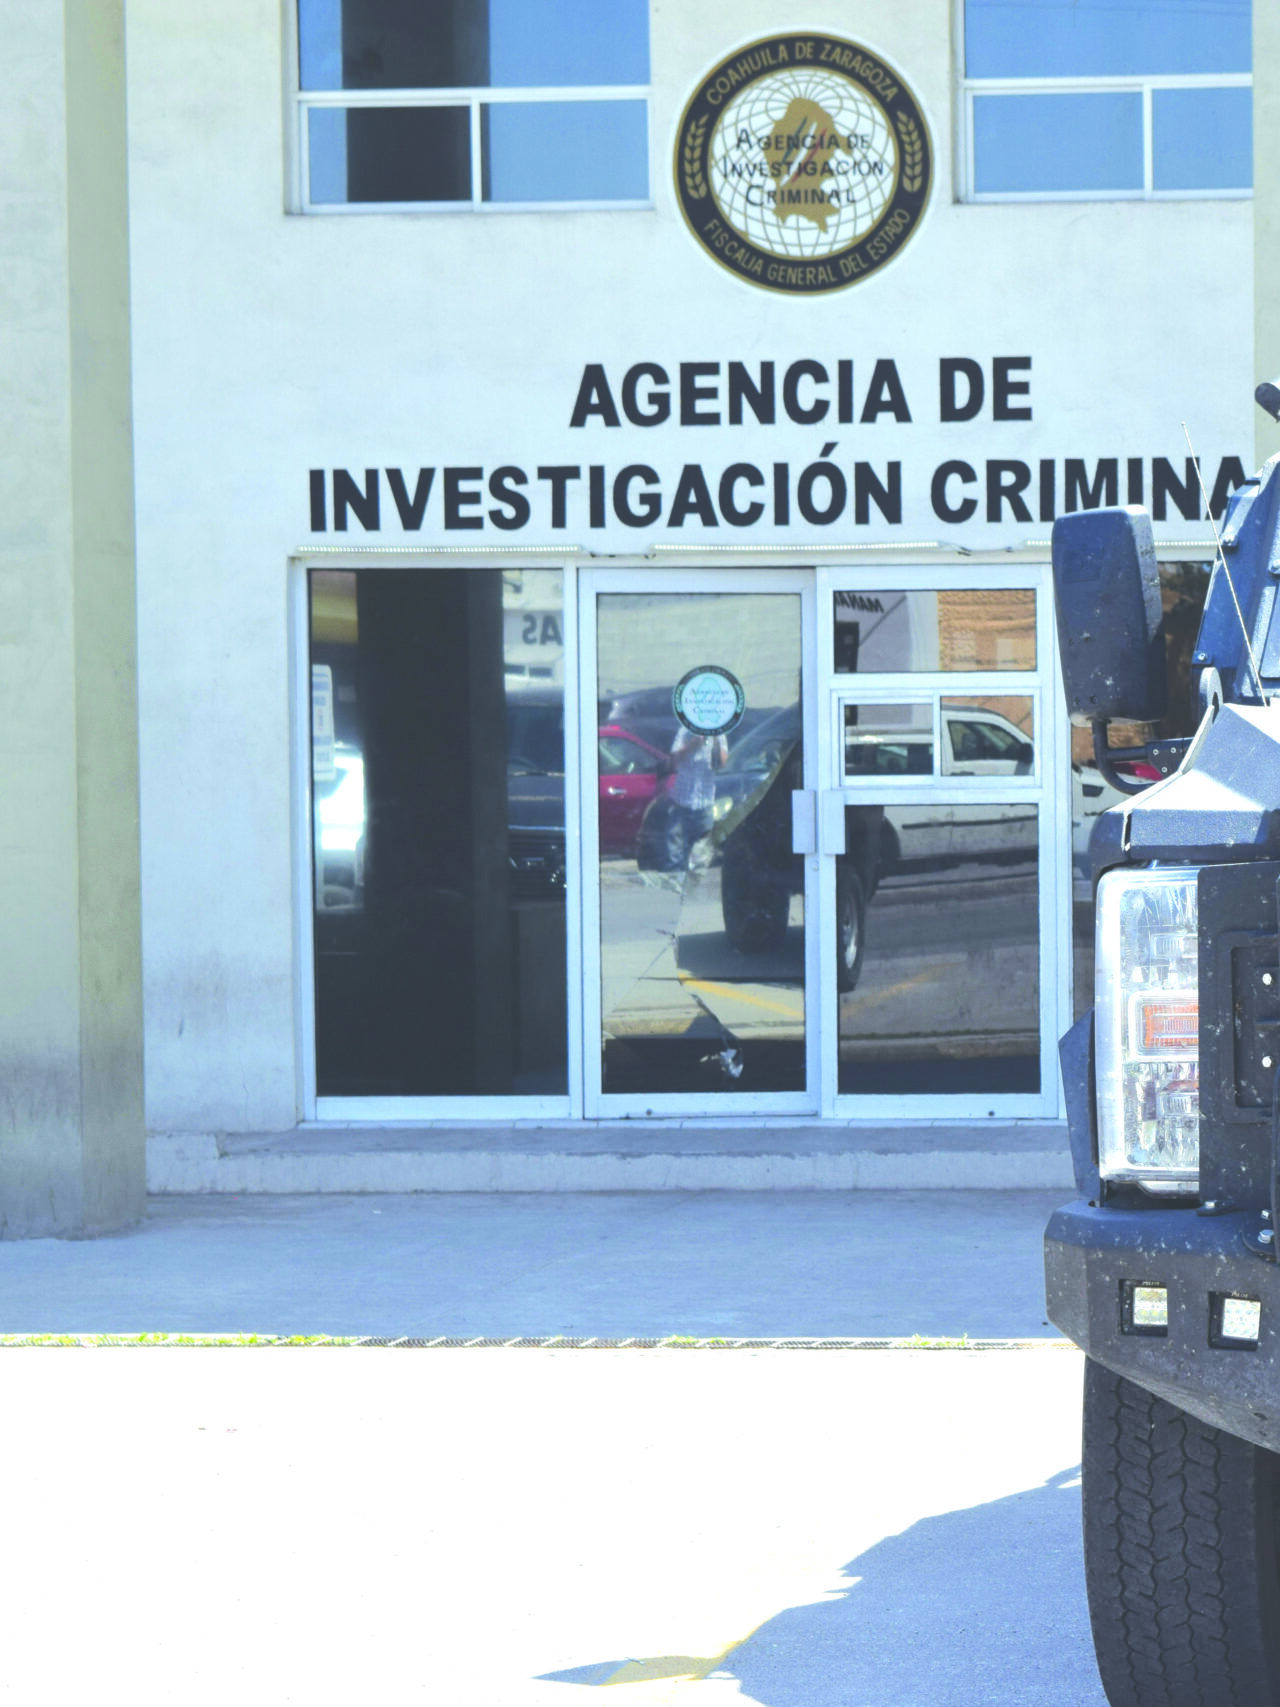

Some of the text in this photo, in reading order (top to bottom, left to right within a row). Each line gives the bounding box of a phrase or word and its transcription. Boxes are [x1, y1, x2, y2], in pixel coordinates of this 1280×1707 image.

[706, 41, 899, 105] COAHUILA DE ZARAGOZA
[736, 128, 870, 151] AGENCIA DE
[745, 184, 857, 207] CRIMINAL
[767, 264, 837, 285] GENERAL
[839, 253, 868, 277] DEL
[867, 208, 910, 260] ESTADO
[569, 356, 1032, 427] AGENCIA DE
[308, 443, 1248, 531] INVESTIGACIÓN CRIMINA
